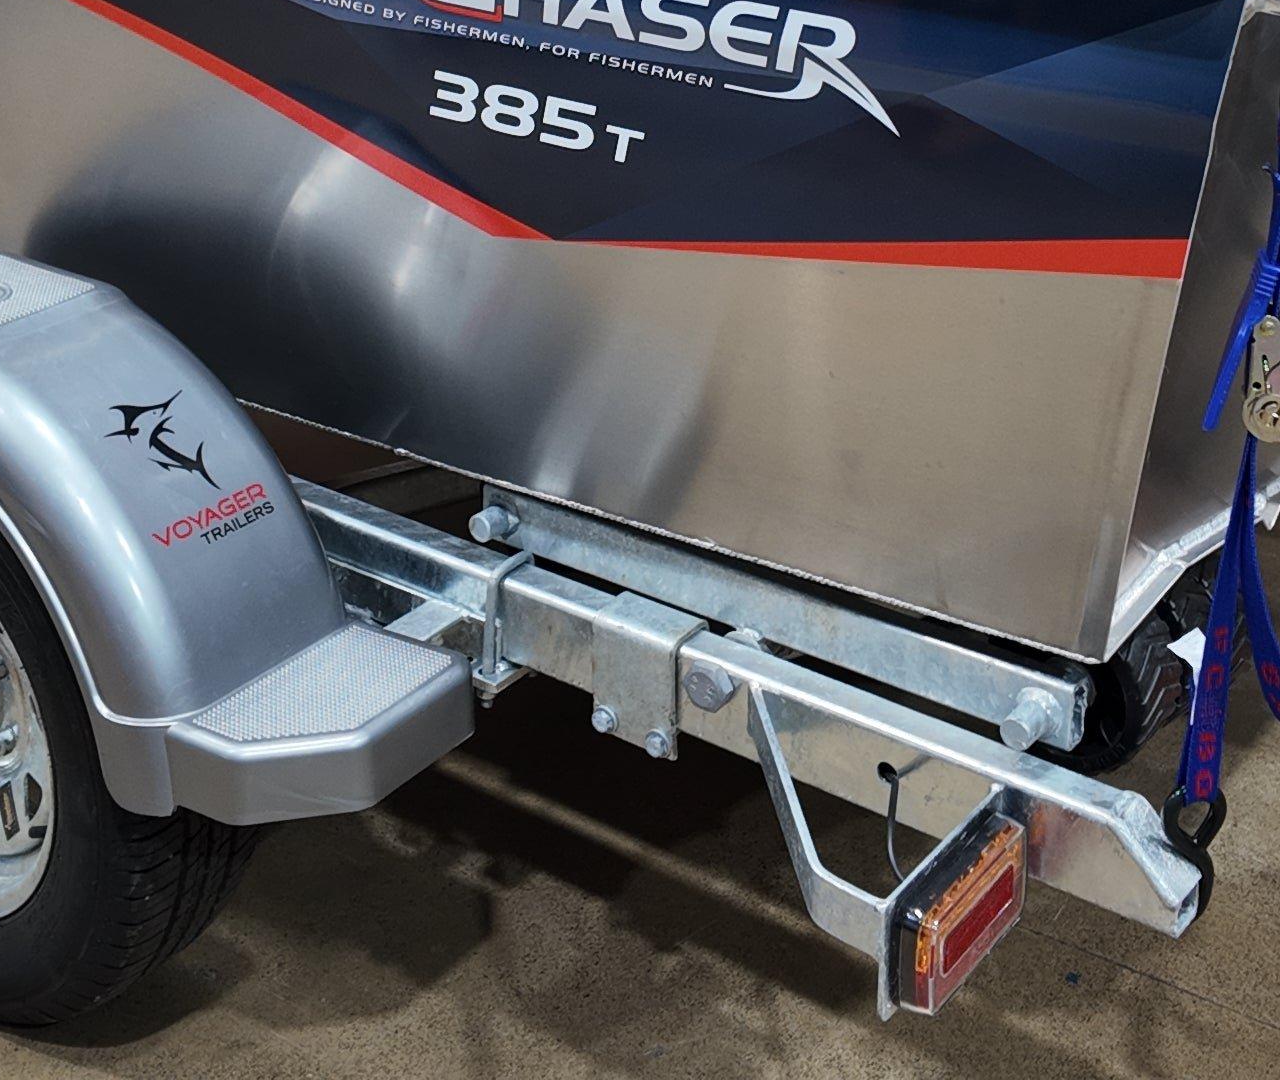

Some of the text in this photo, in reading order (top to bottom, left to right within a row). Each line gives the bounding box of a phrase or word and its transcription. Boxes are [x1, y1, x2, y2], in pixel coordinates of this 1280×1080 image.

[382, 7, 408, 21] BY
[413, 14, 530, 50] FISHERMEN,
[539, 41, 581, 61] FOR
[588, 52, 714, 88] FISHERMEN
[151, 482, 267, 547] VOYAGER
[200, 501, 275, 545] TRAILERS
